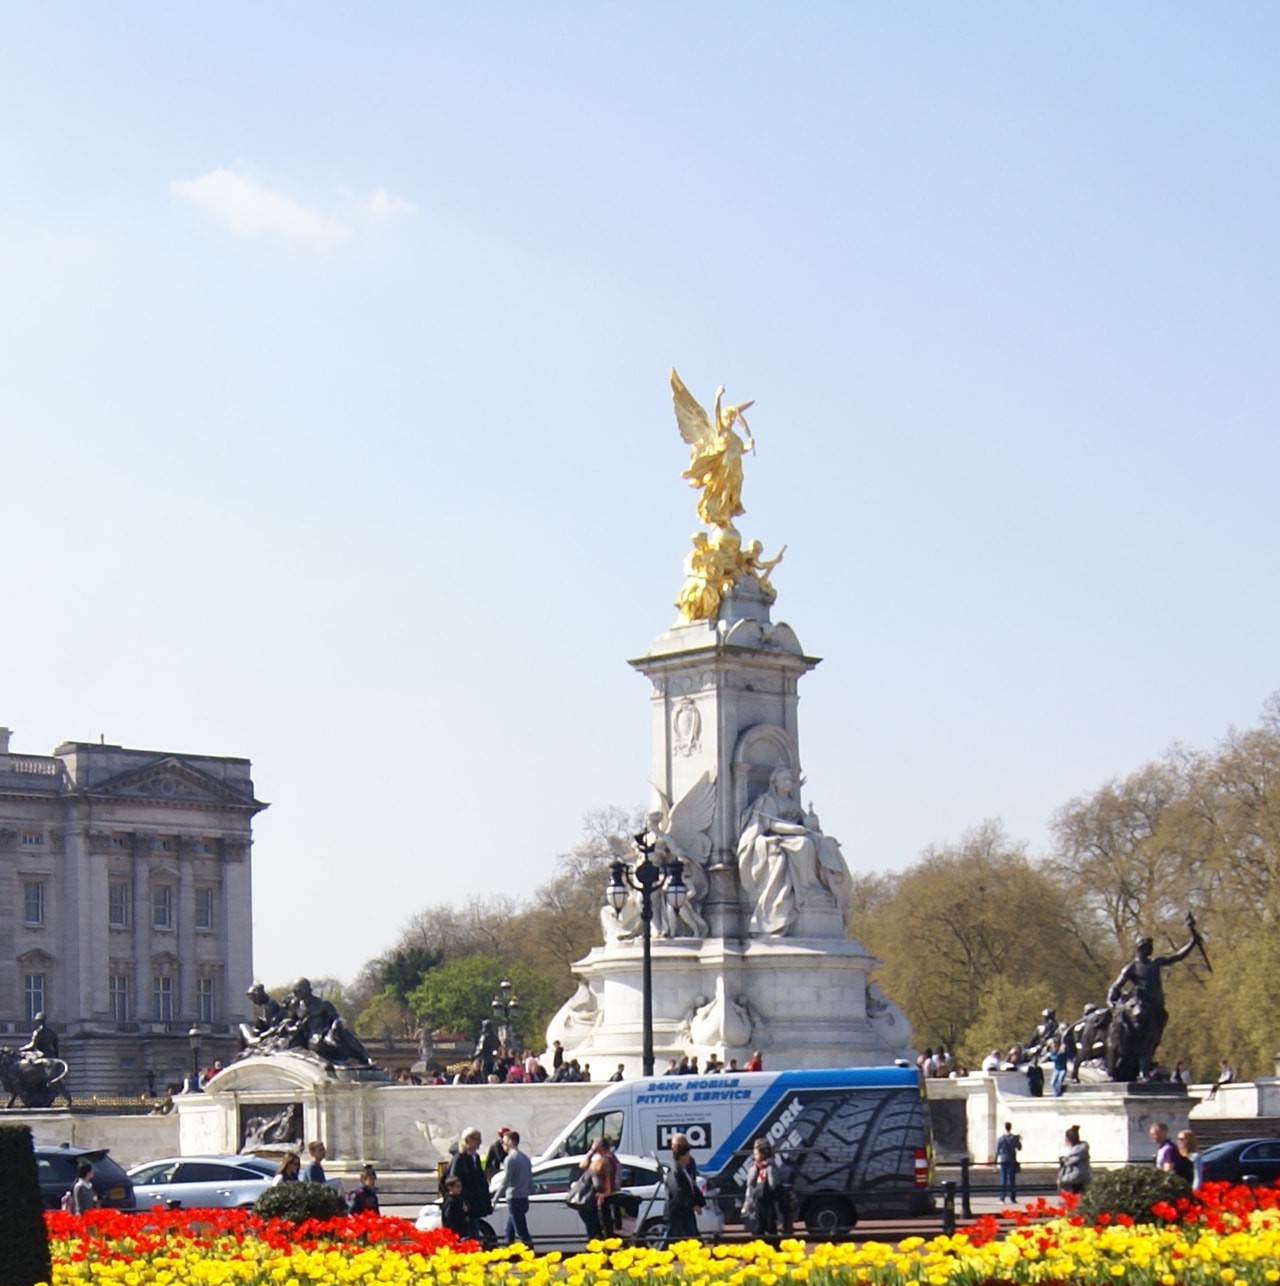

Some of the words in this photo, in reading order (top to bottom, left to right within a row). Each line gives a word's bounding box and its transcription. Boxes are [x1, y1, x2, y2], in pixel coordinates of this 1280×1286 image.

[686, 1079, 740, 1090] MOBILE
[636, 1092, 689, 1104] FITTING
[692, 1089, 752, 1101] SERVICE
[661, 1125, 706, 1147] HQ
